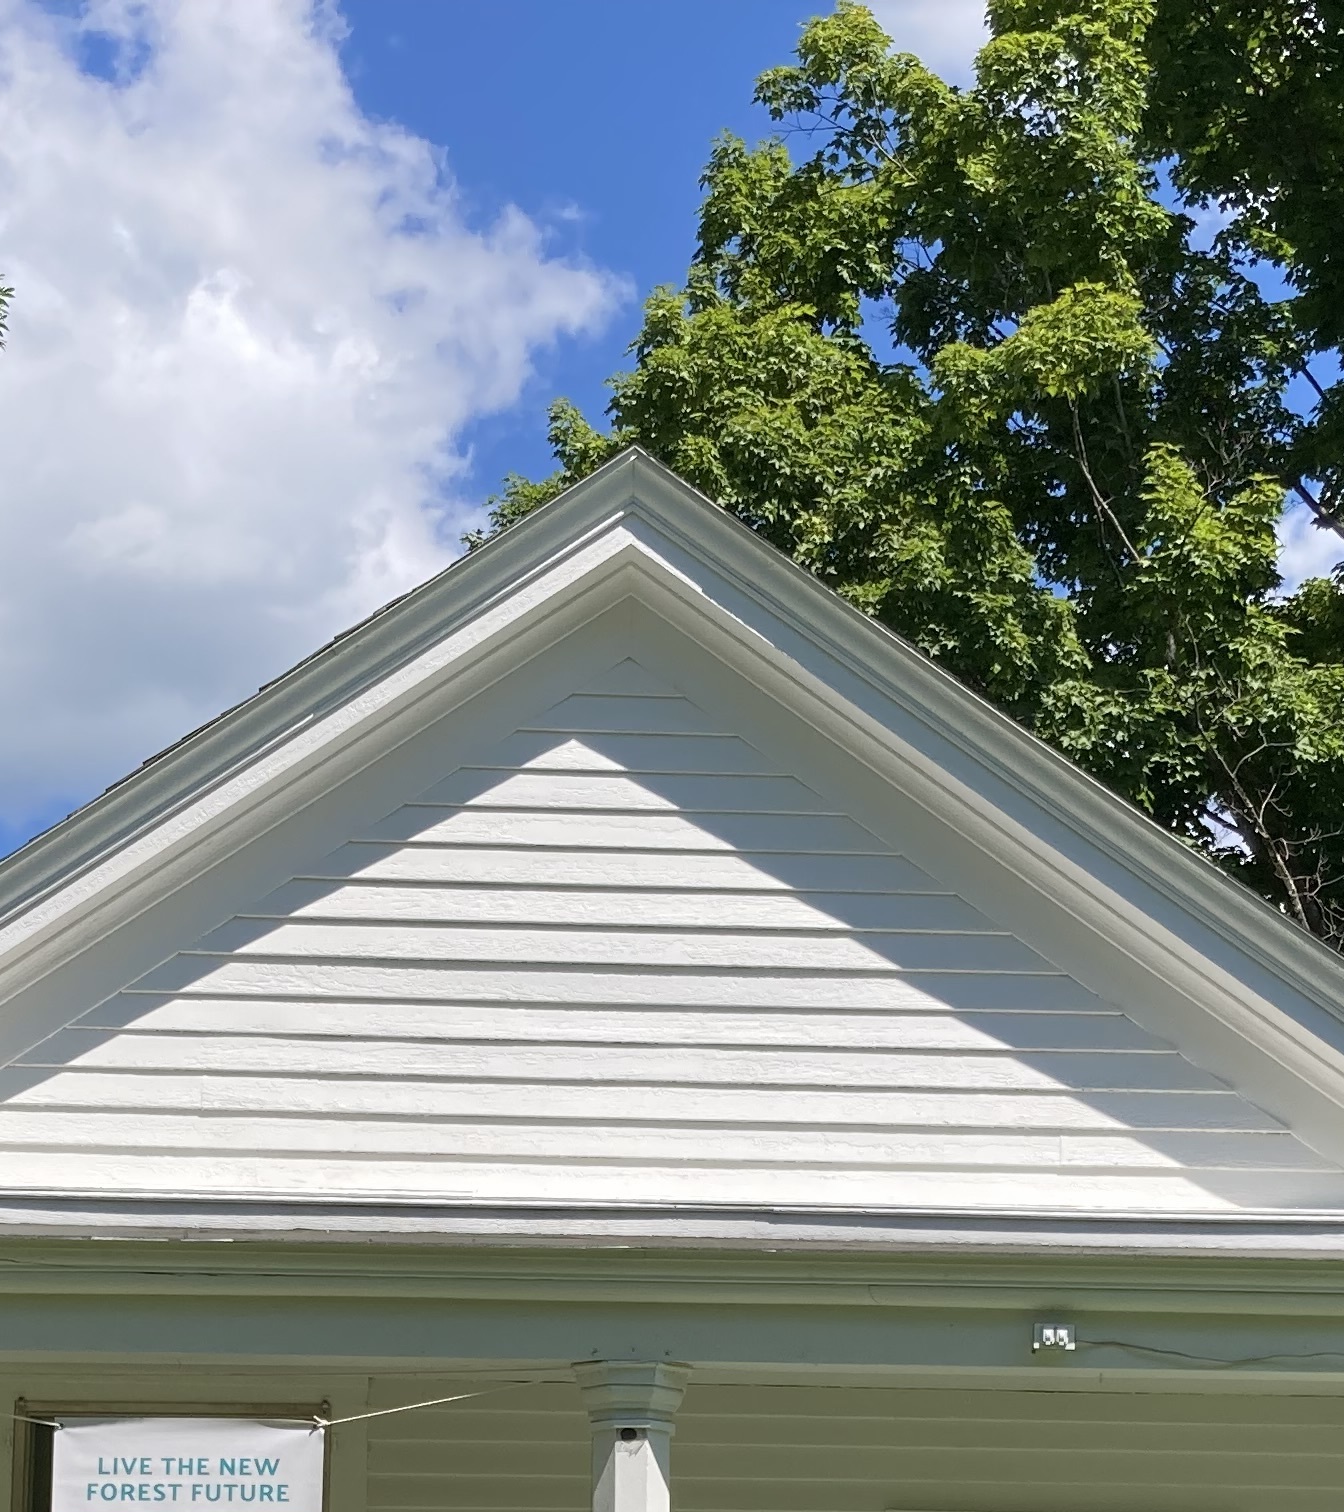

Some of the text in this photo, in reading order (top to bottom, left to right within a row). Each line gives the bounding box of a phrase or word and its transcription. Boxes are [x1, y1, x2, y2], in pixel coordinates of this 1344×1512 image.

[97, 1457, 281, 1476] LIVE THE NEW
[87, 1483, 290, 1502] FOREST FUTURE
